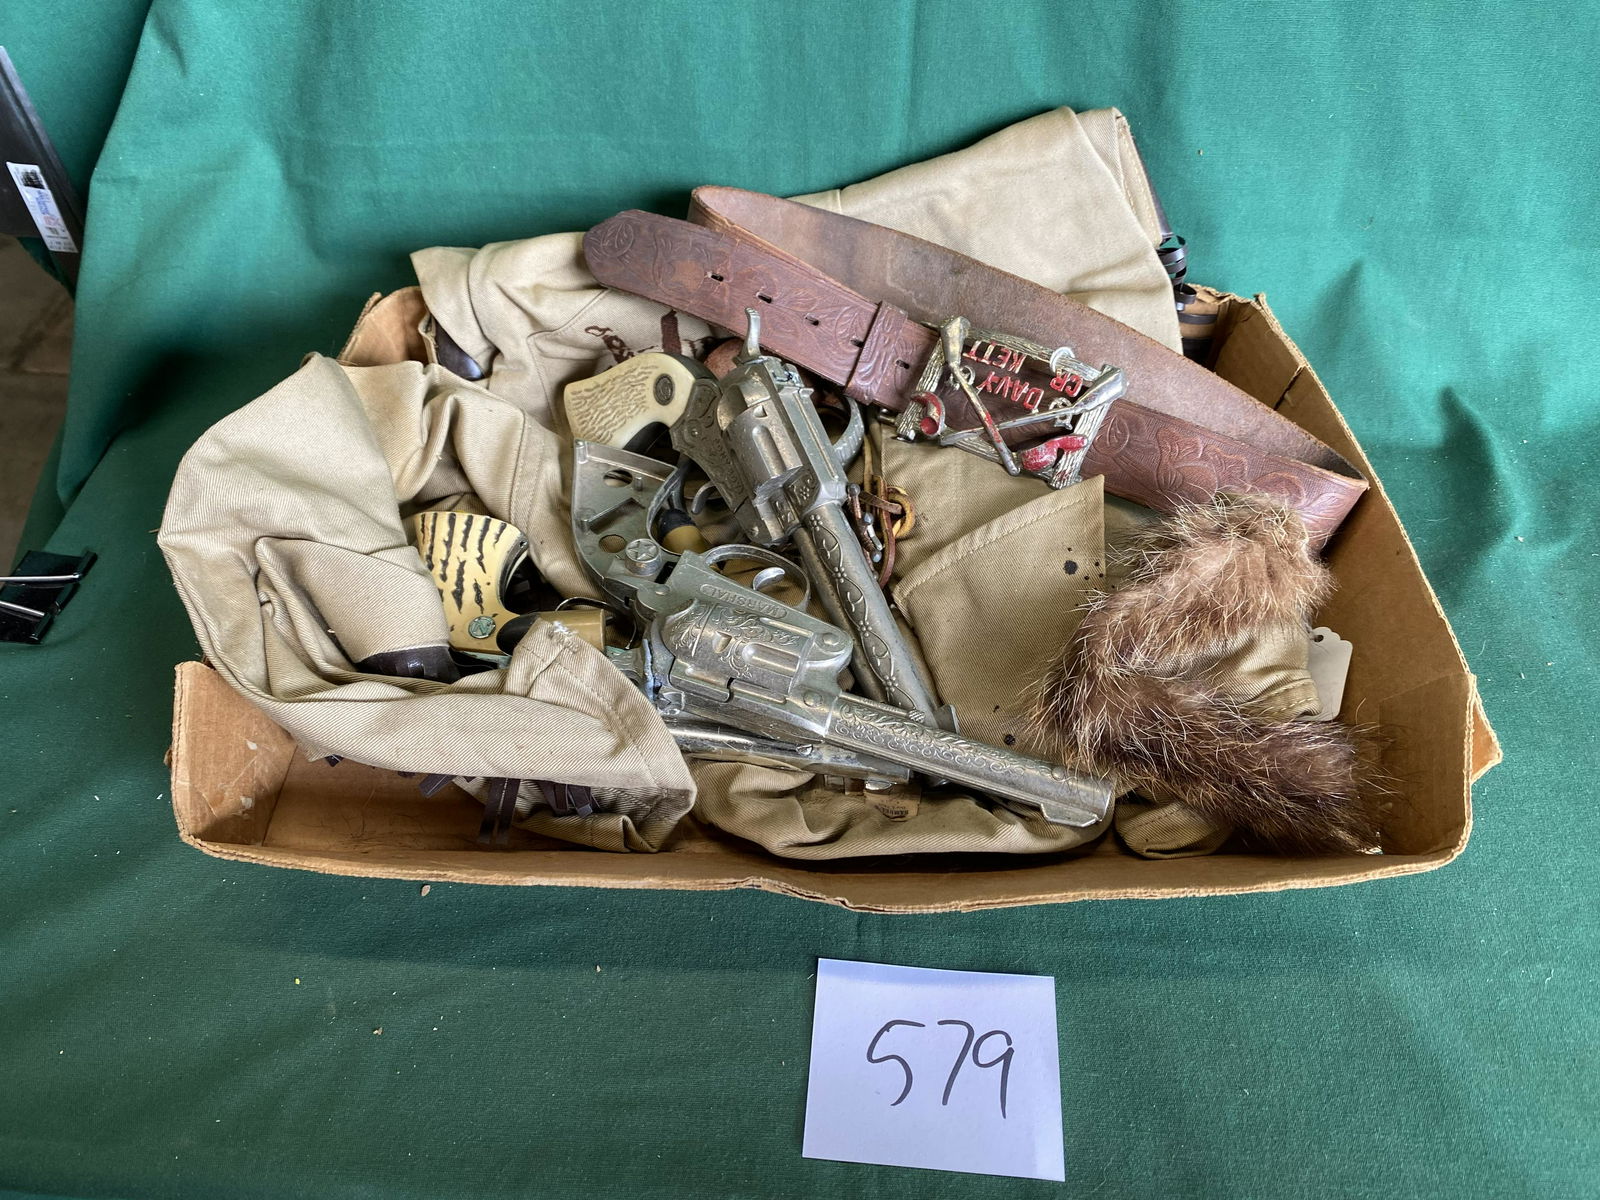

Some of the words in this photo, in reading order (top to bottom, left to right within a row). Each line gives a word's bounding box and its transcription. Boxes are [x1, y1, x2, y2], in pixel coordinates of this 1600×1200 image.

[963, 340, 1027, 373] KETT
[976, 371, 1044, 410] DAVY
[1050, 369, 1083, 397] CR
[708, 586, 781, 618] MARSHAL
[866, 1019, 1014, 1119] 579
